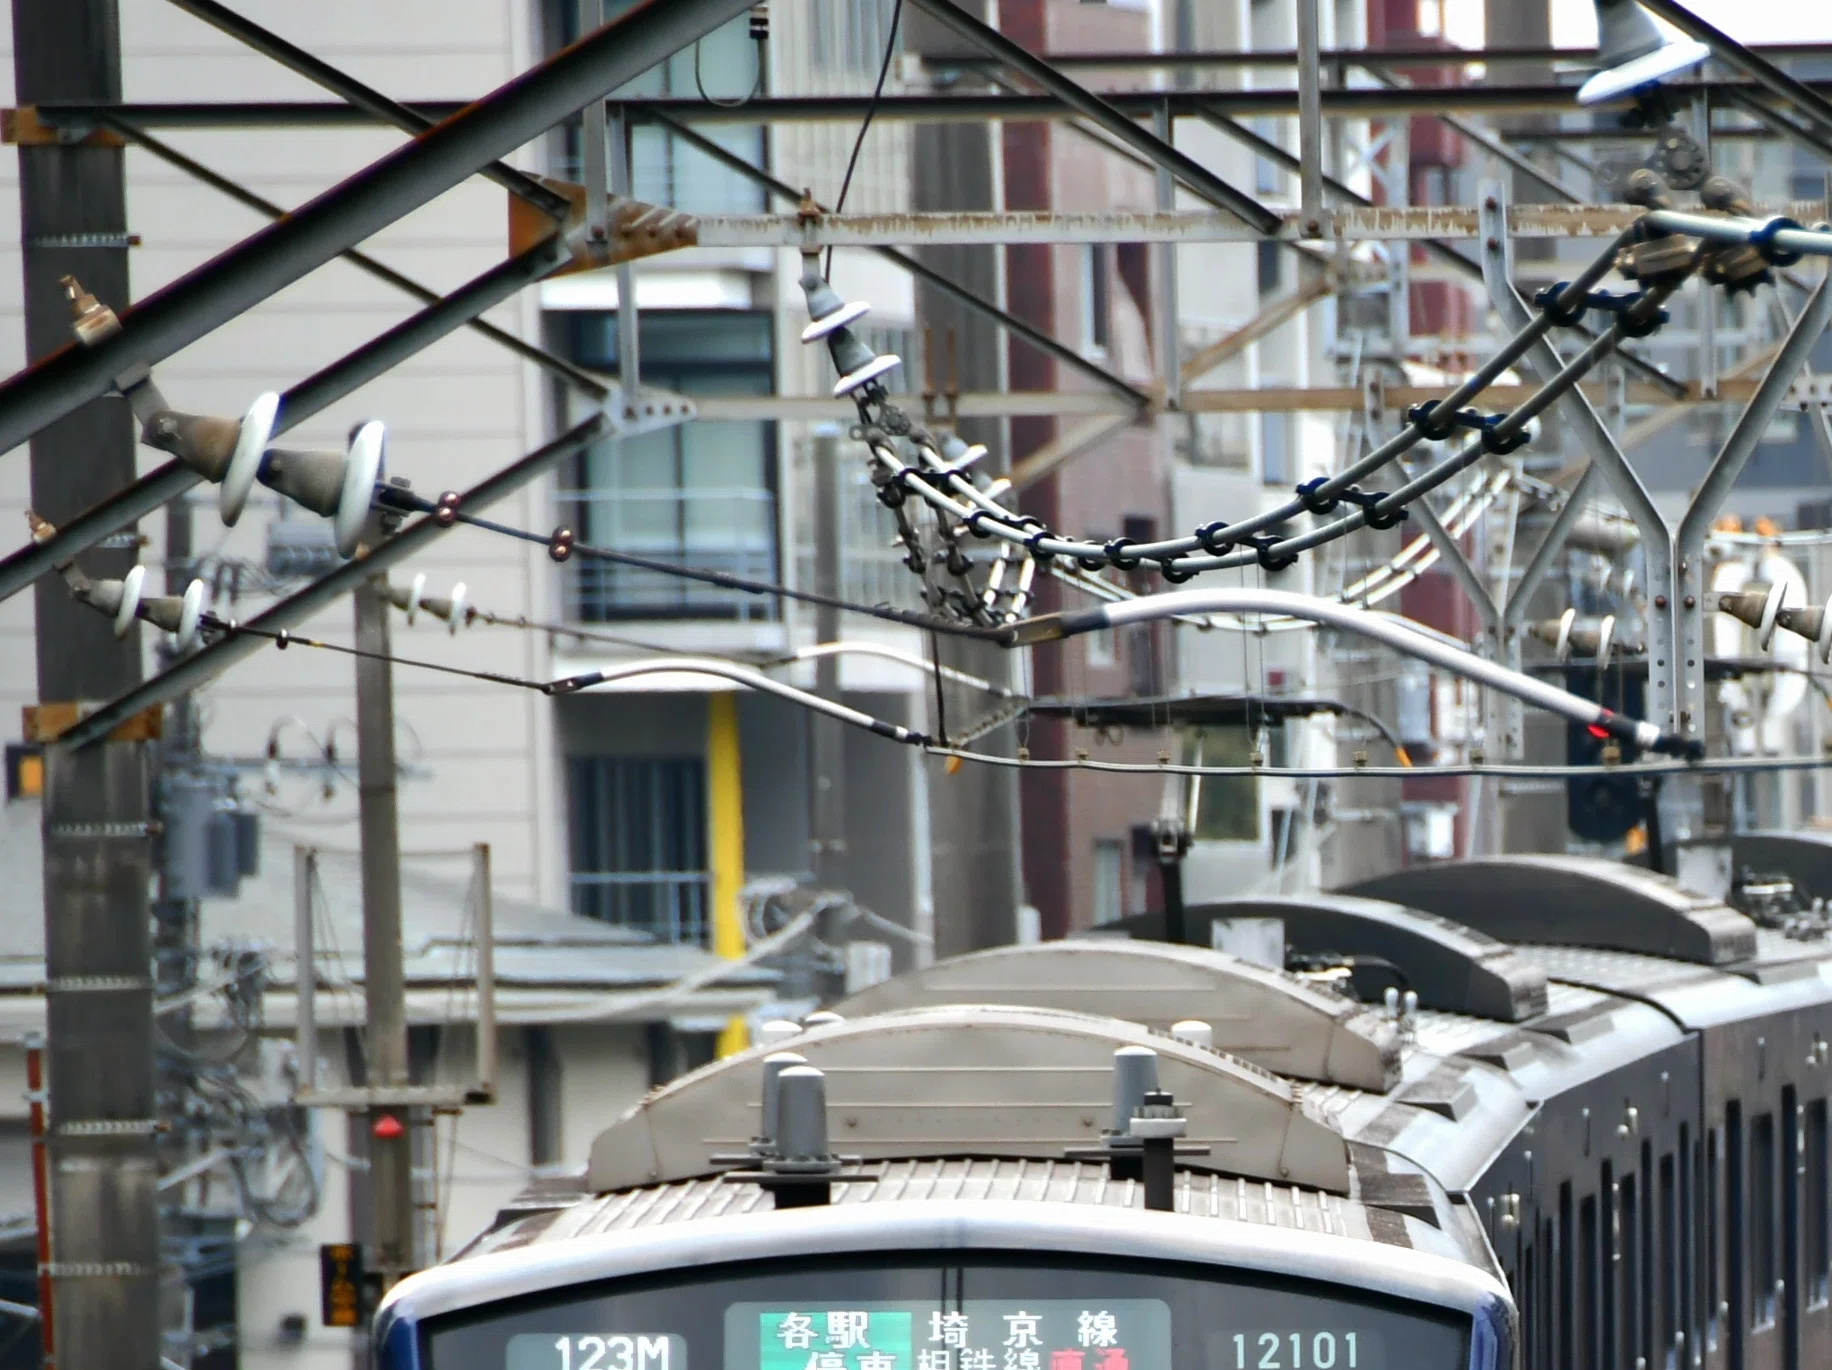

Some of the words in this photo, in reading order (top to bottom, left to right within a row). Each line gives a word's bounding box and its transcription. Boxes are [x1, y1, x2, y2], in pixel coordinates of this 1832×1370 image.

[776, 1311, 870, 1350] 各駅
[927, 1310, 1119, 1348] 埼京線
[1232, 1331, 1357, 1370] 12101
